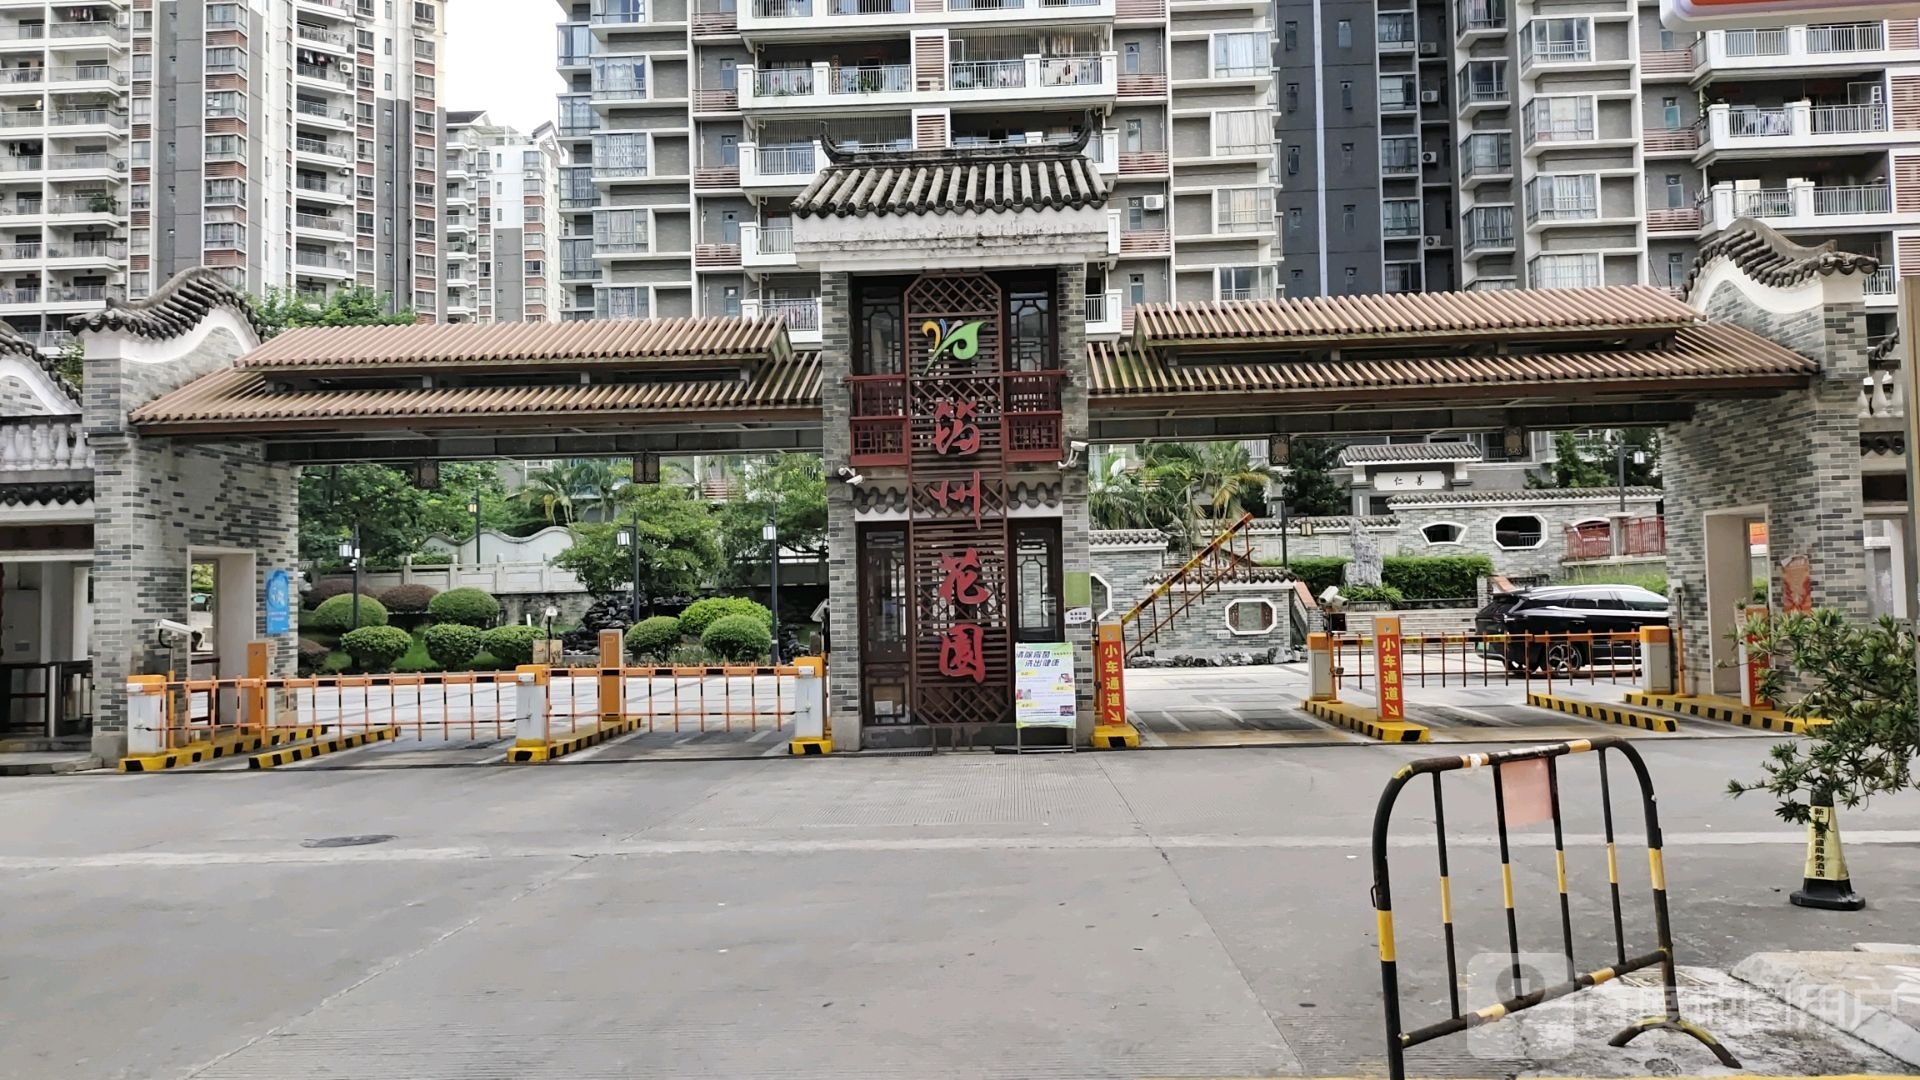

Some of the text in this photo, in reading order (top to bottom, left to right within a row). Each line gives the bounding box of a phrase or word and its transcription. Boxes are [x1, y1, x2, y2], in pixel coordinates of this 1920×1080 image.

[1105, 644, 1121, 707] 小车通道
[1382, 637, 1399, 700] 小车通道
